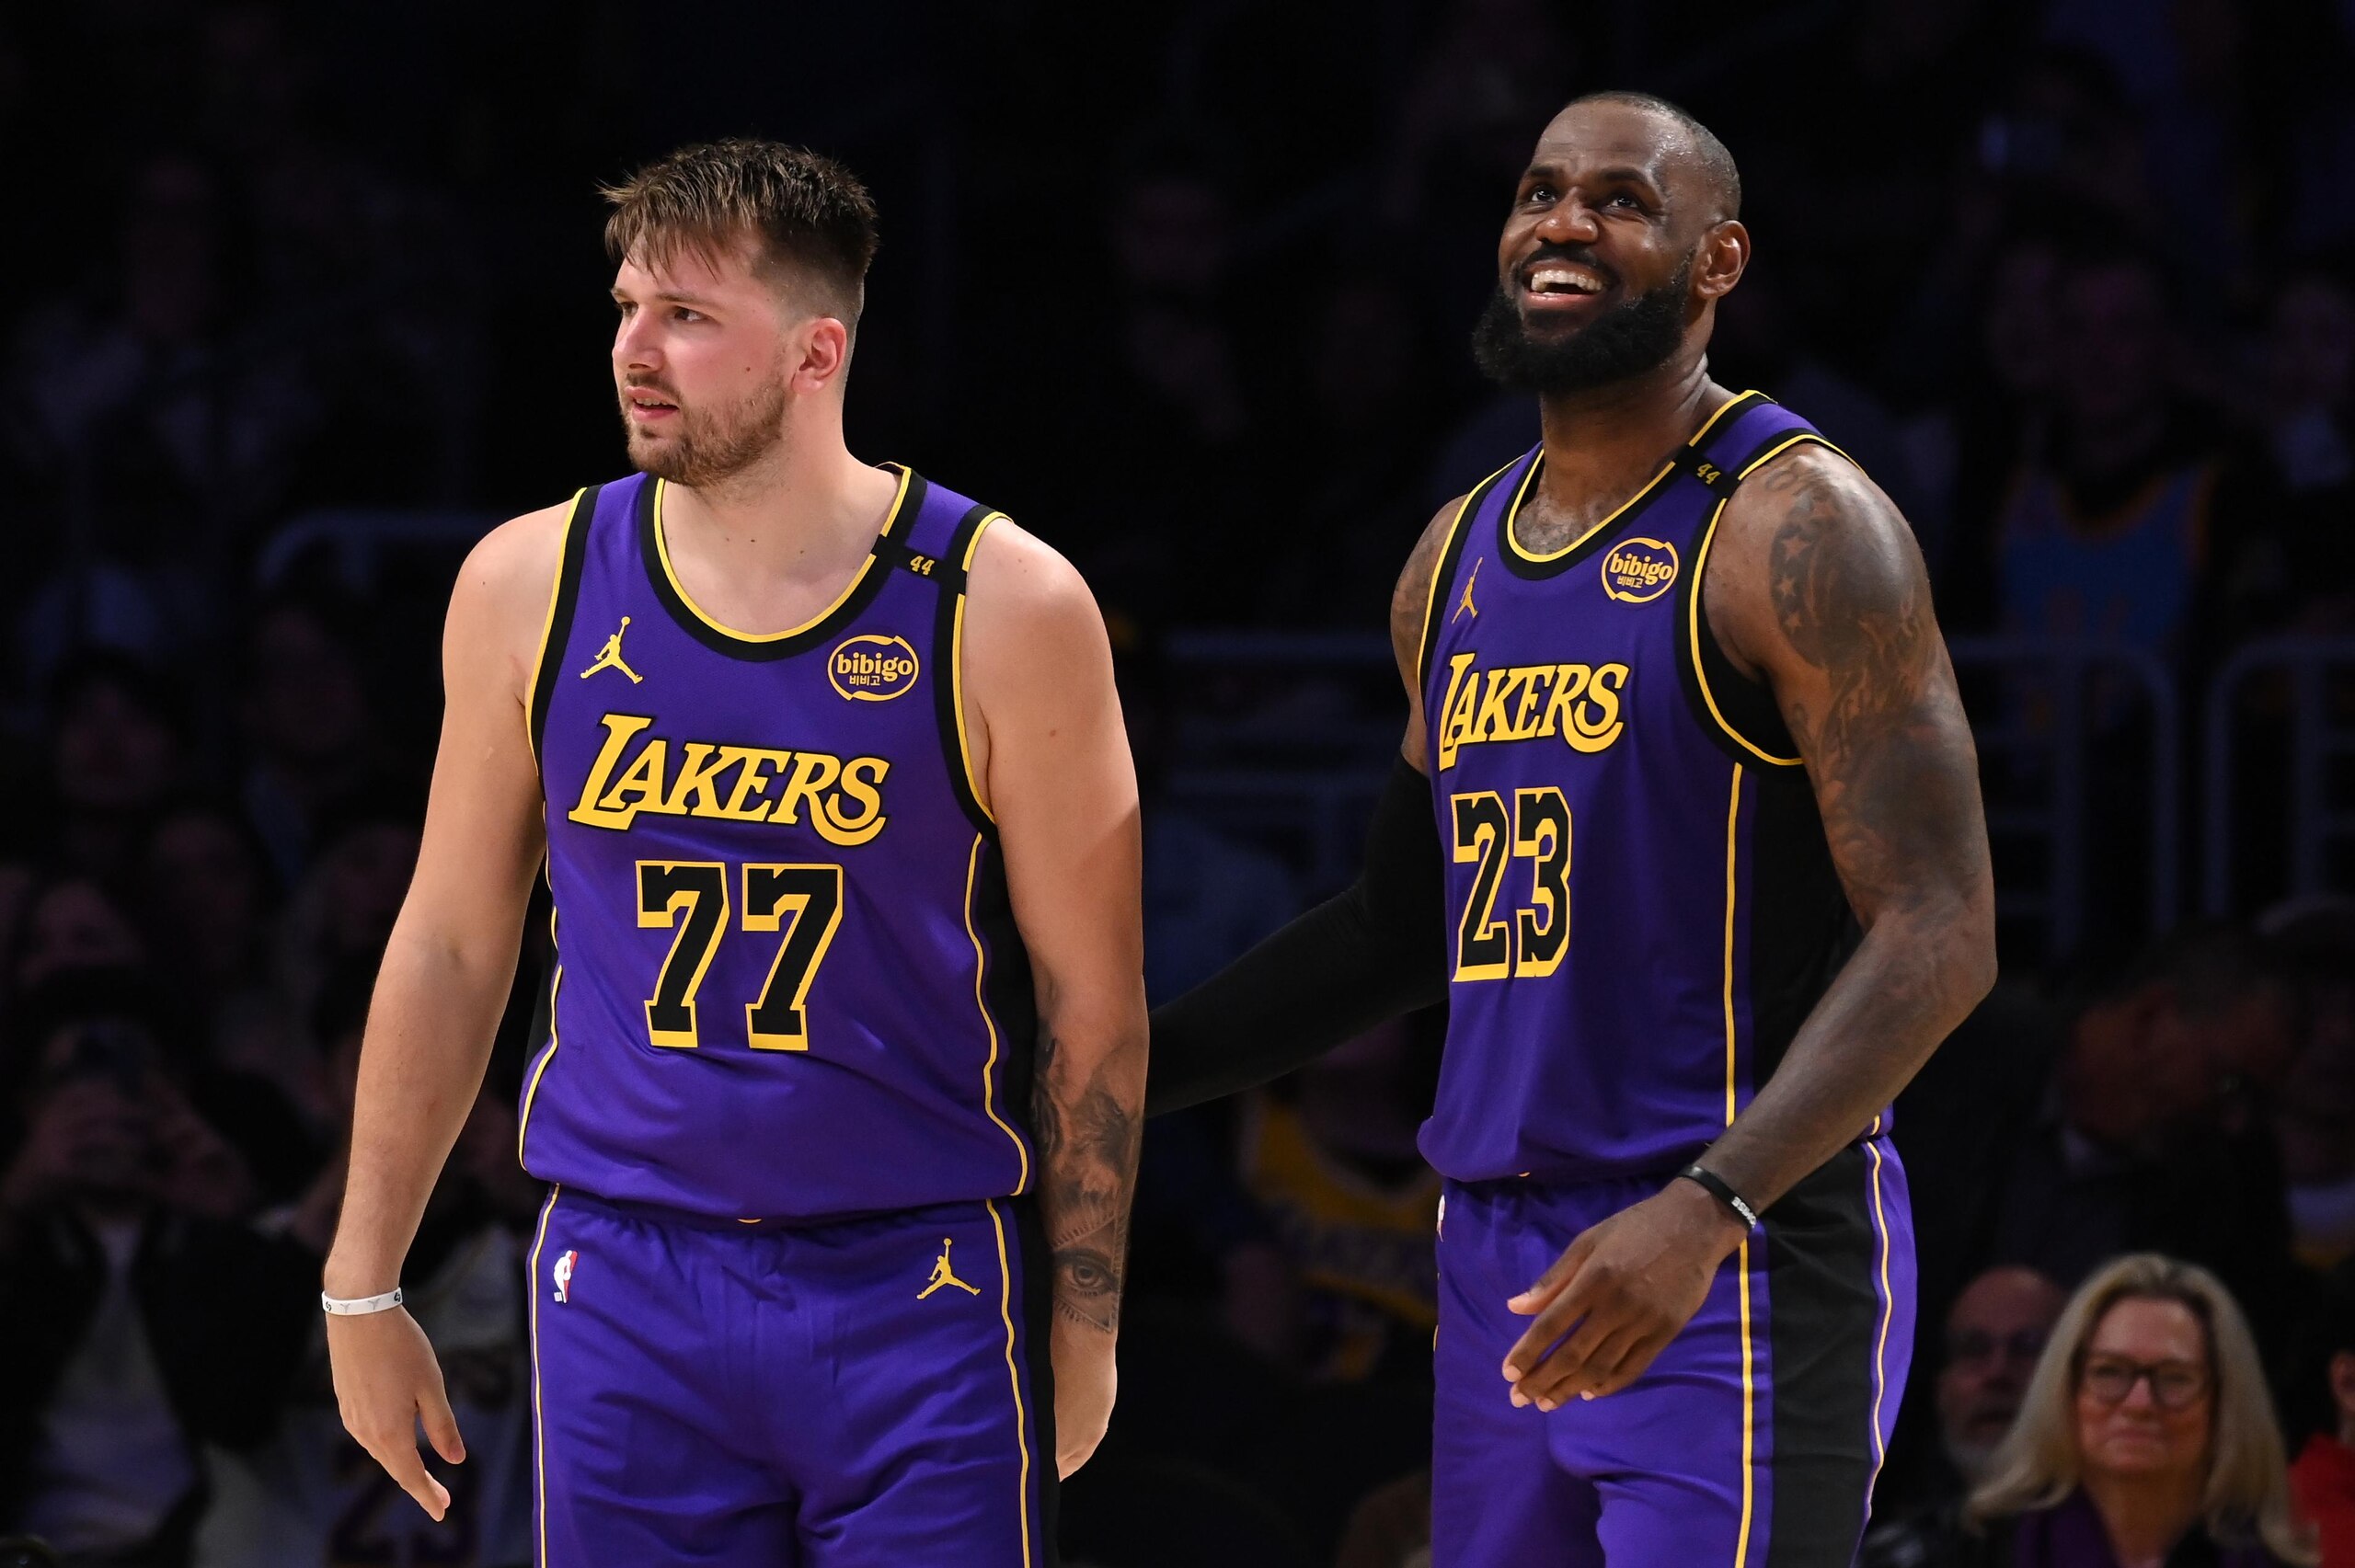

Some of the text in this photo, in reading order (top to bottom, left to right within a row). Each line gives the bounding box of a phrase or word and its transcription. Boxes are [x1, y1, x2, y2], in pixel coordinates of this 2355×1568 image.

[1696, 463, 1721, 485] 44
[910, 555, 935, 576] 44
[1609, 553, 1673, 586] bibigo
[1616, 575, 1644, 589] 비비고
[836, 651, 913, 682] bibigo
[848, 674, 880, 686] 비비고
[1438, 651, 1630, 771] LAKERS
[567, 712, 890, 847] LAKERS
[1450, 785, 1573, 982] 23
[635, 859, 844, 1052] 77
